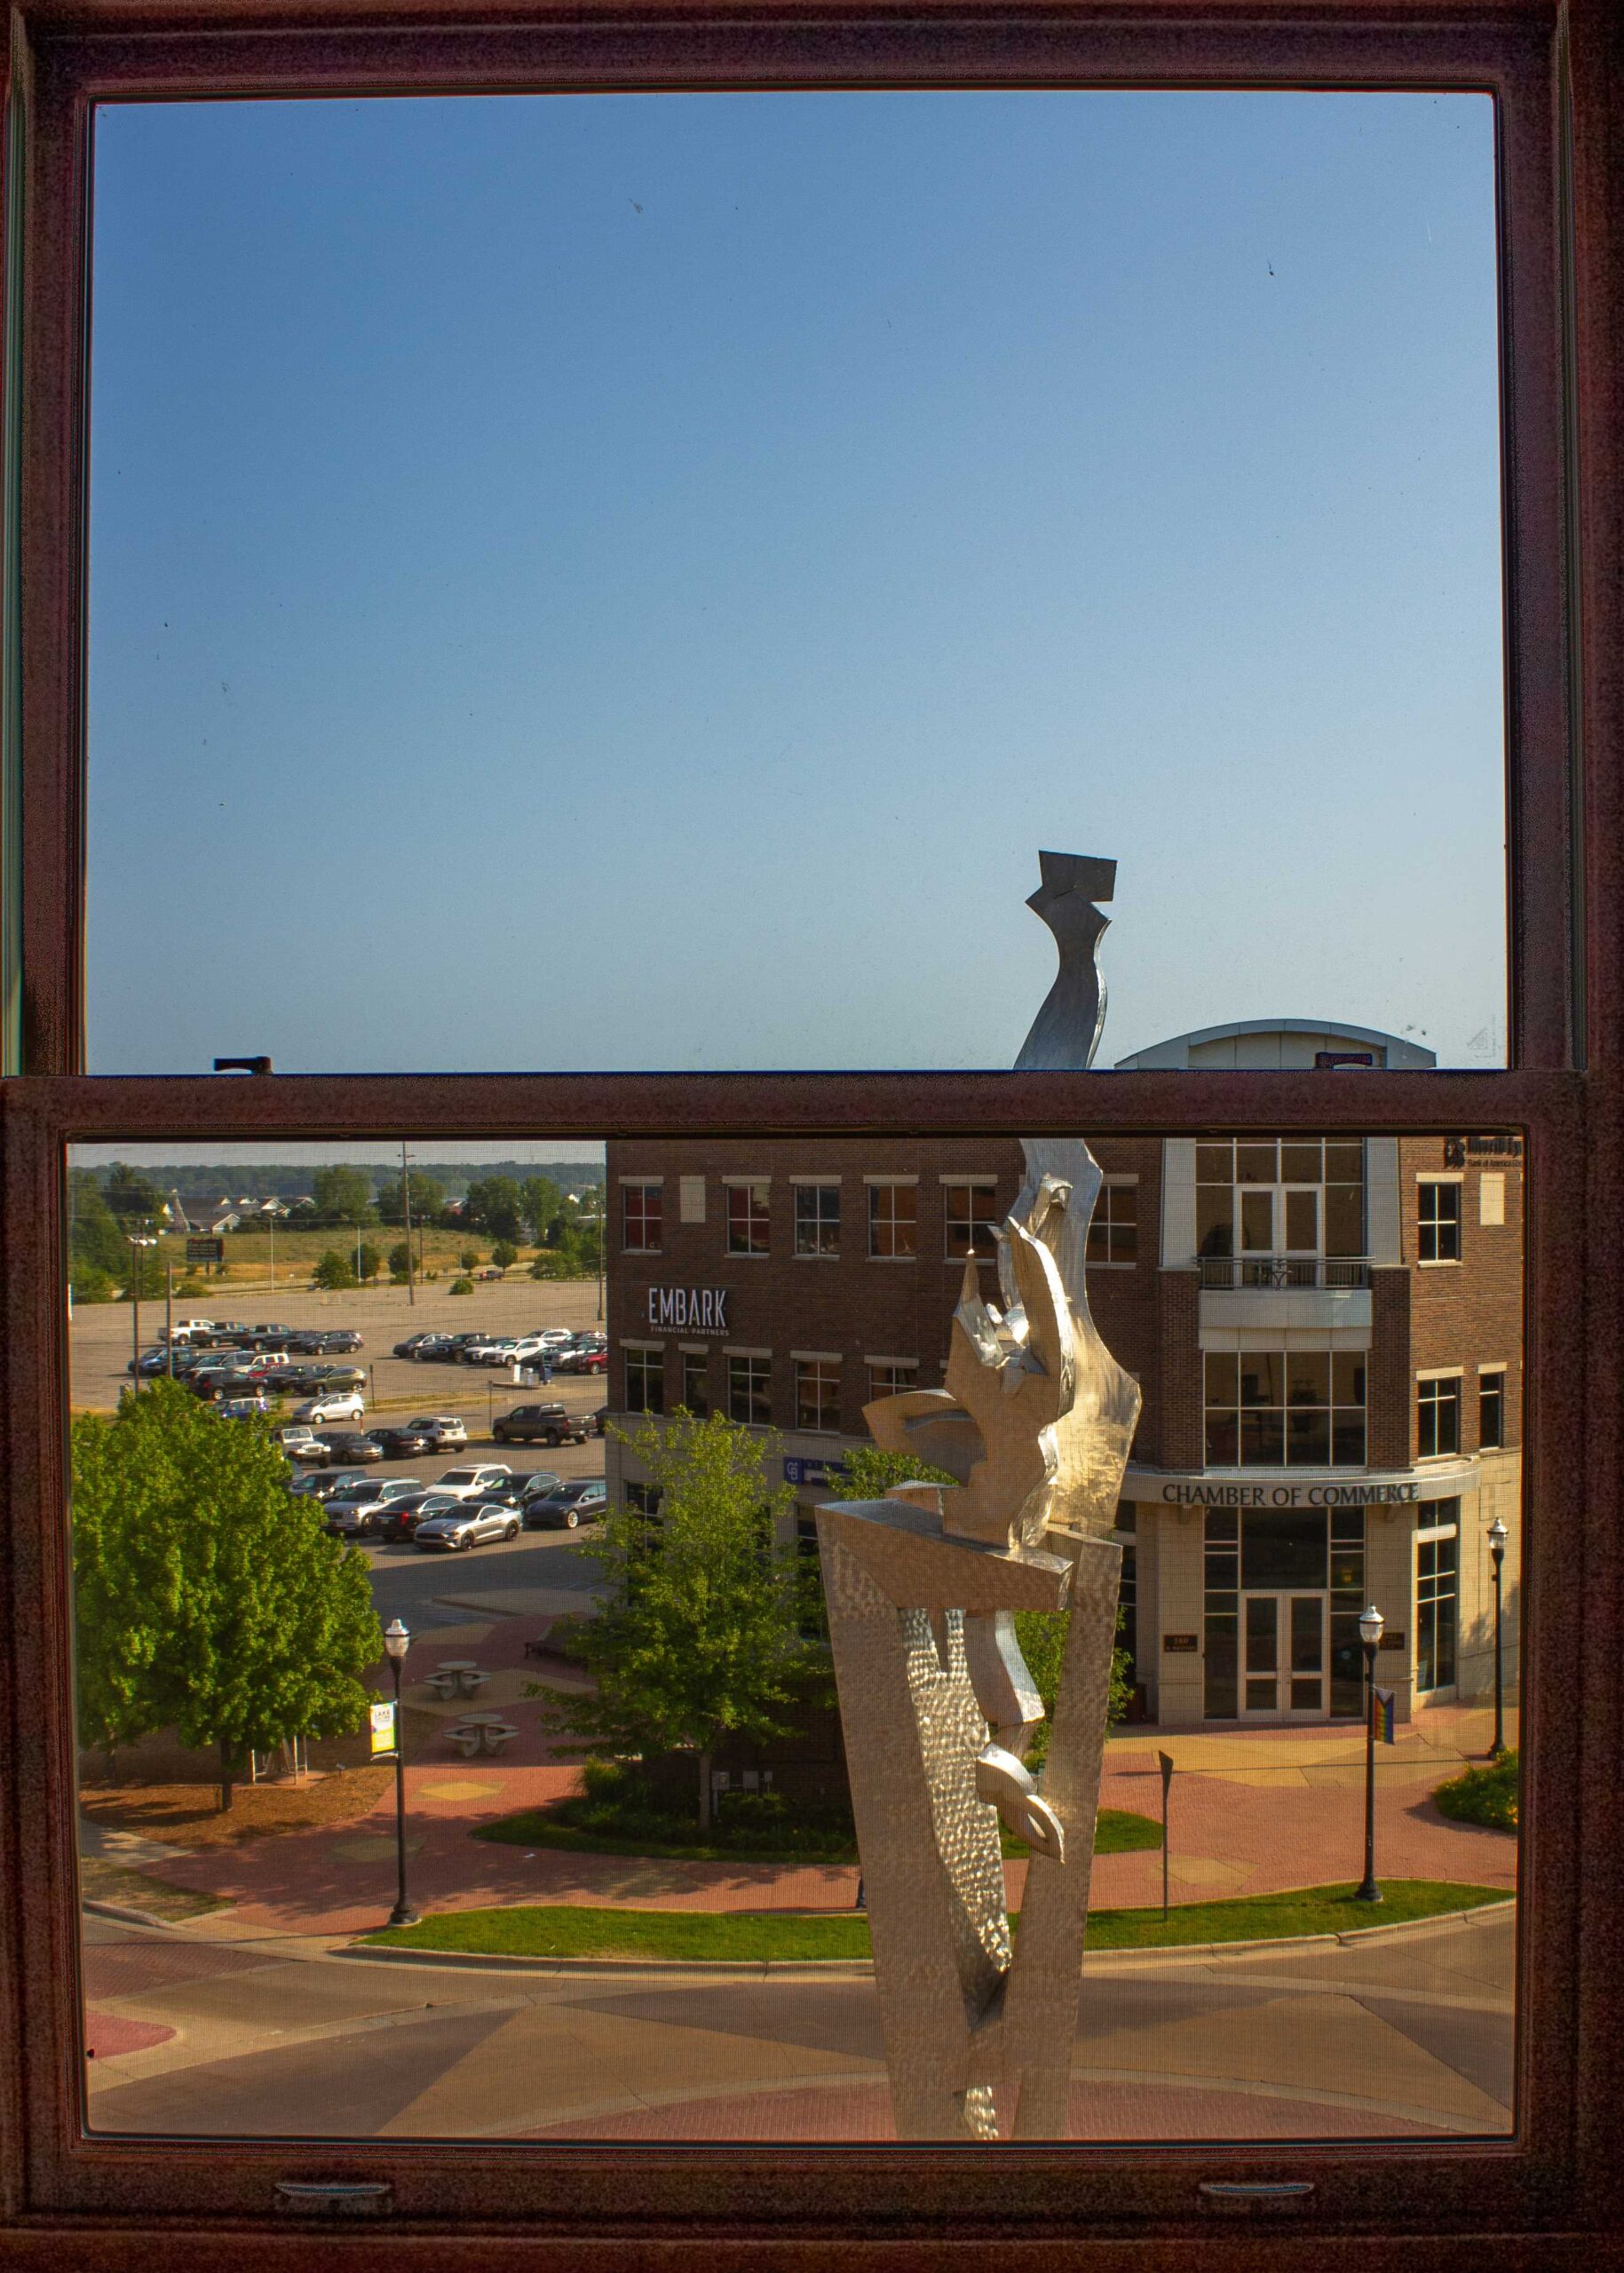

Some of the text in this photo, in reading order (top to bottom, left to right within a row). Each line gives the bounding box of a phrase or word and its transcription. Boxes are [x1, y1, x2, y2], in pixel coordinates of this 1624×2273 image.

[648, 1287, 727, 1327] EMBARK
[650, 1326, 730, 1336] FINANCIAL PARTNERS
[1162, 1482, 1420, 1507] CHAMBER OF COMMERCE
